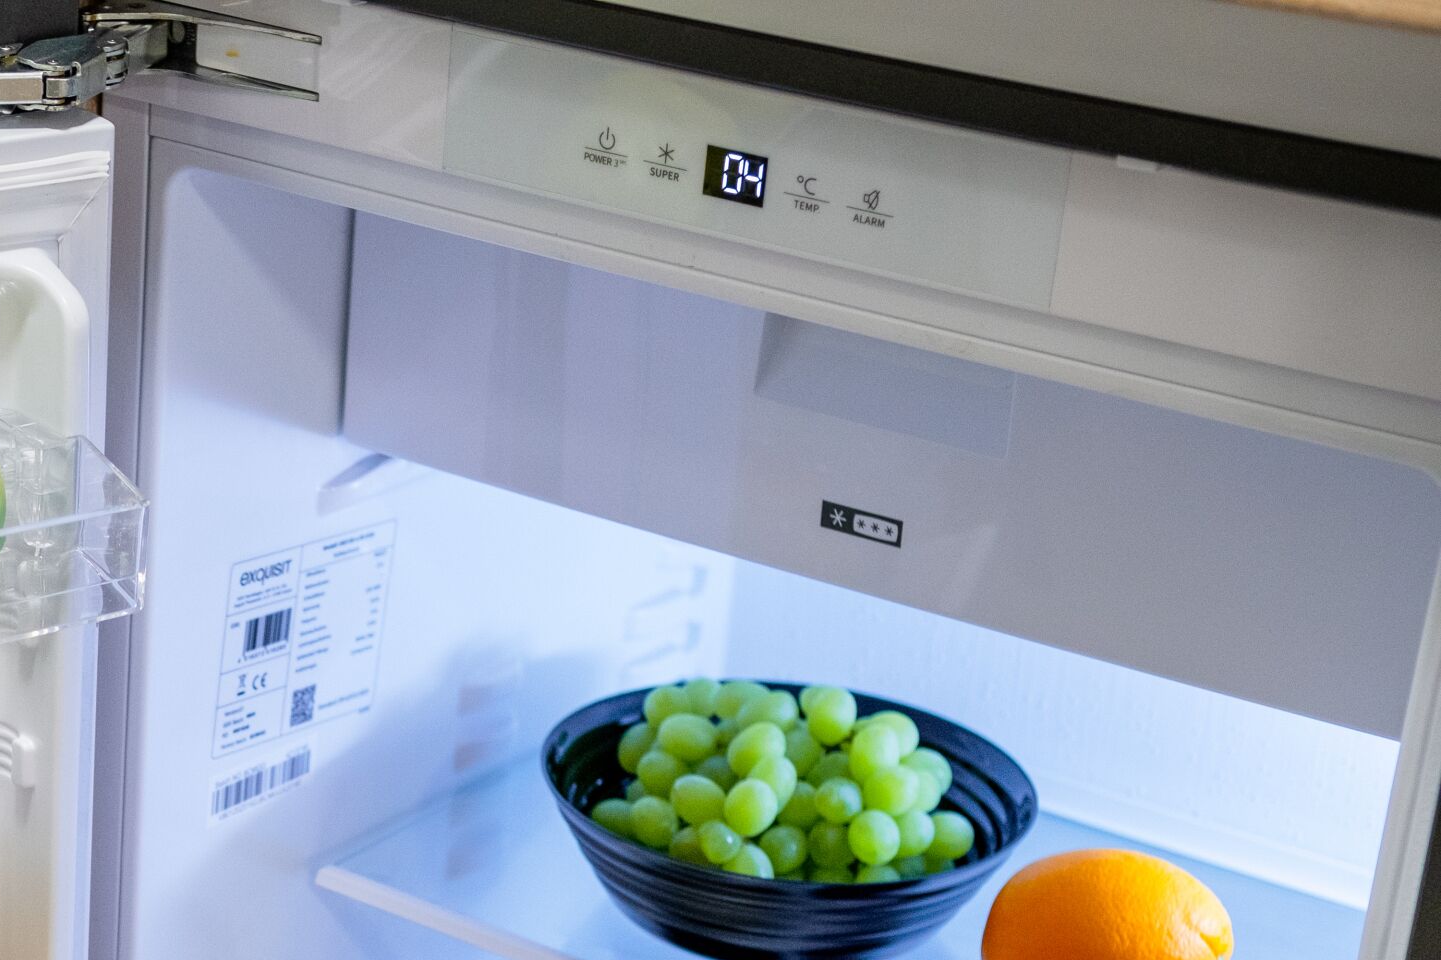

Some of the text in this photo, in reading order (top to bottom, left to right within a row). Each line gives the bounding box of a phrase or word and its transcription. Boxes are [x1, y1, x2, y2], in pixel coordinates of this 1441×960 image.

[583, 152, 612, 166] POWER
[649, 167, 680, 182] SUPER
[722, 153, 764, 198] 04
[853, 213, 886, 229] ALARM
